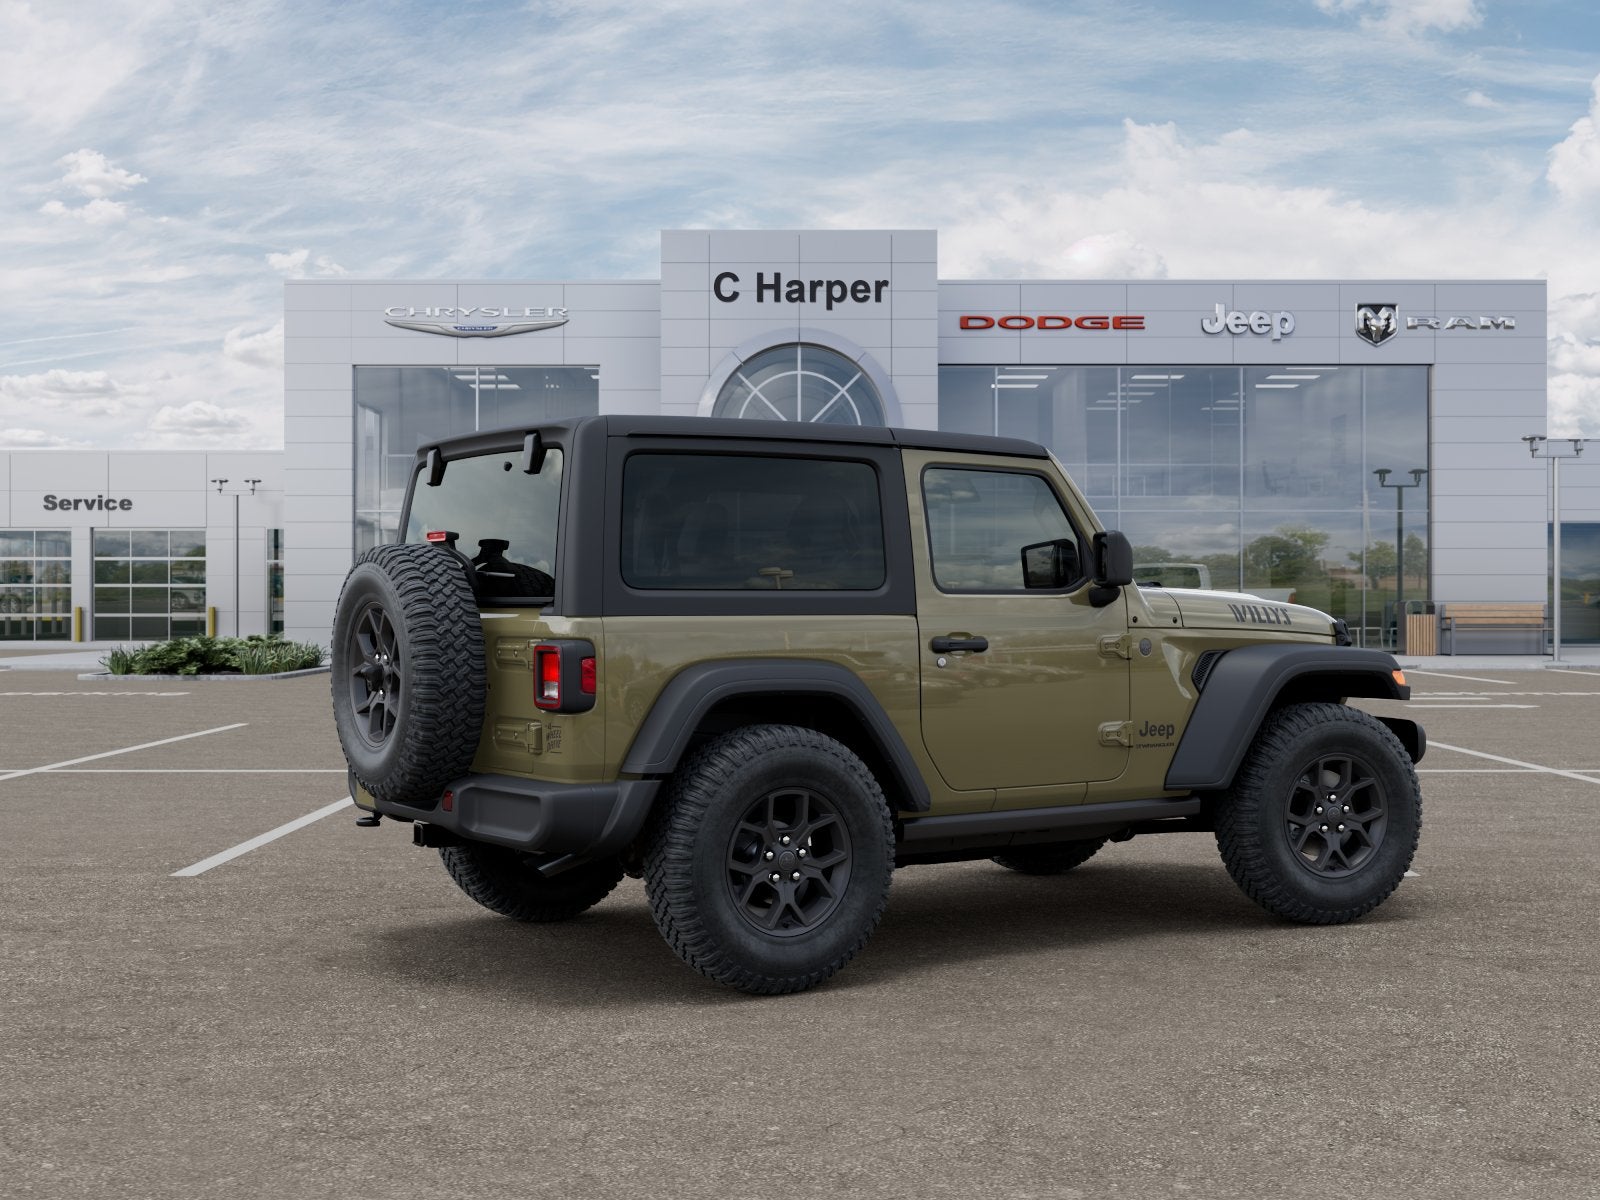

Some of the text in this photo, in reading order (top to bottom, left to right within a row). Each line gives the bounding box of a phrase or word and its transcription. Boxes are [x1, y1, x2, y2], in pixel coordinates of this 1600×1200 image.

[713, 271, 890, 311] C Harper
[384, 306, 569, 317] CHRYSLER
[959, 315, 1146, 330] DODGE
[1201, 303, 1295, 342] Jeep
[1406, 316, 1516, 330] RAM
[43, 494, 133, 511] Service
[1227, 604, 1292, 625] WILLYS
[1139, 720, 1175, 739] Jeep
